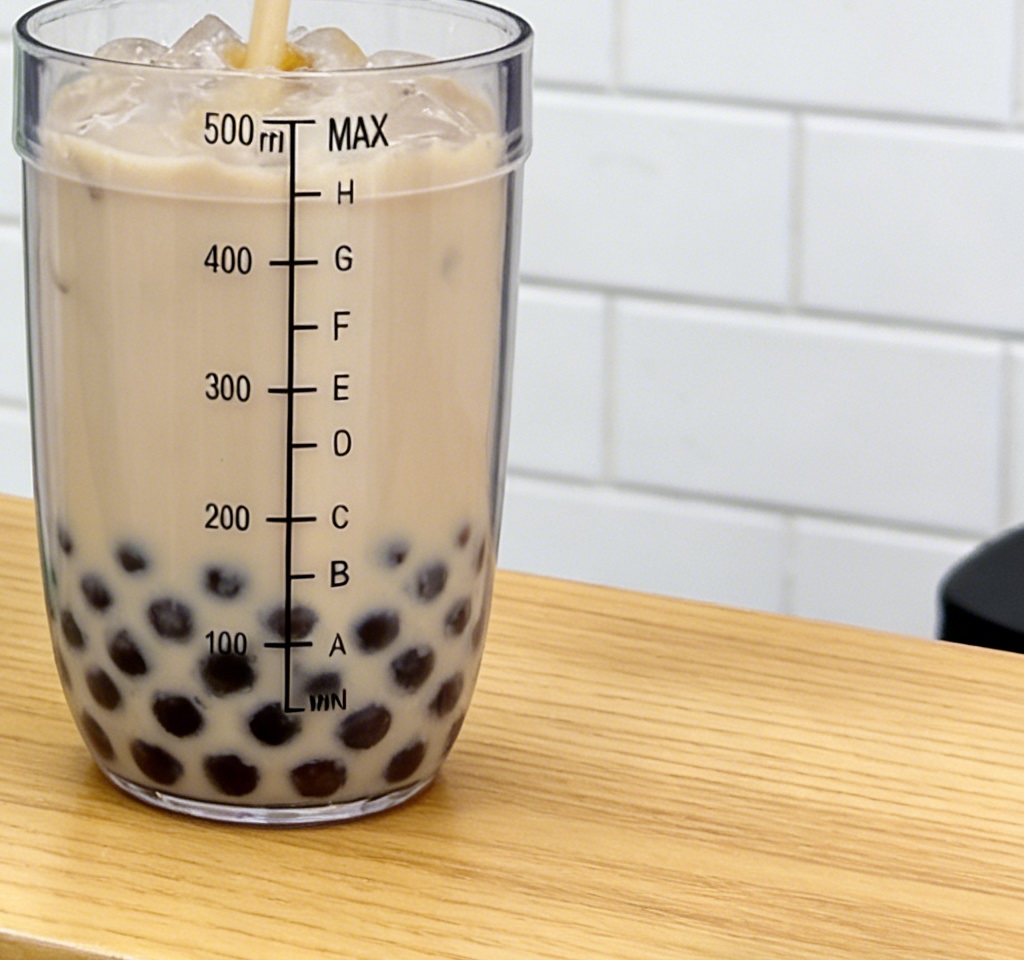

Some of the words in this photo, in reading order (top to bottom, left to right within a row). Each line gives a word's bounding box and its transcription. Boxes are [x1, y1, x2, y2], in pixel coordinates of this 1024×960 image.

[329, 113, 389, 151] MAX
[337, 178, 354, 205] H
[204, 244, 252, 275] 400
[334, 245, 353, 271] G
[333, 311, 351, 341] F
[205, 372, 251, 402] 300
[333, 374, 350, 401] E
[204, 503, 250, 531] 200
[332, 505, 349, 529] C
[330, 560, 349, 588] B
[205, 630, 247, 657] 100
[329, 632, 347, 658] A
